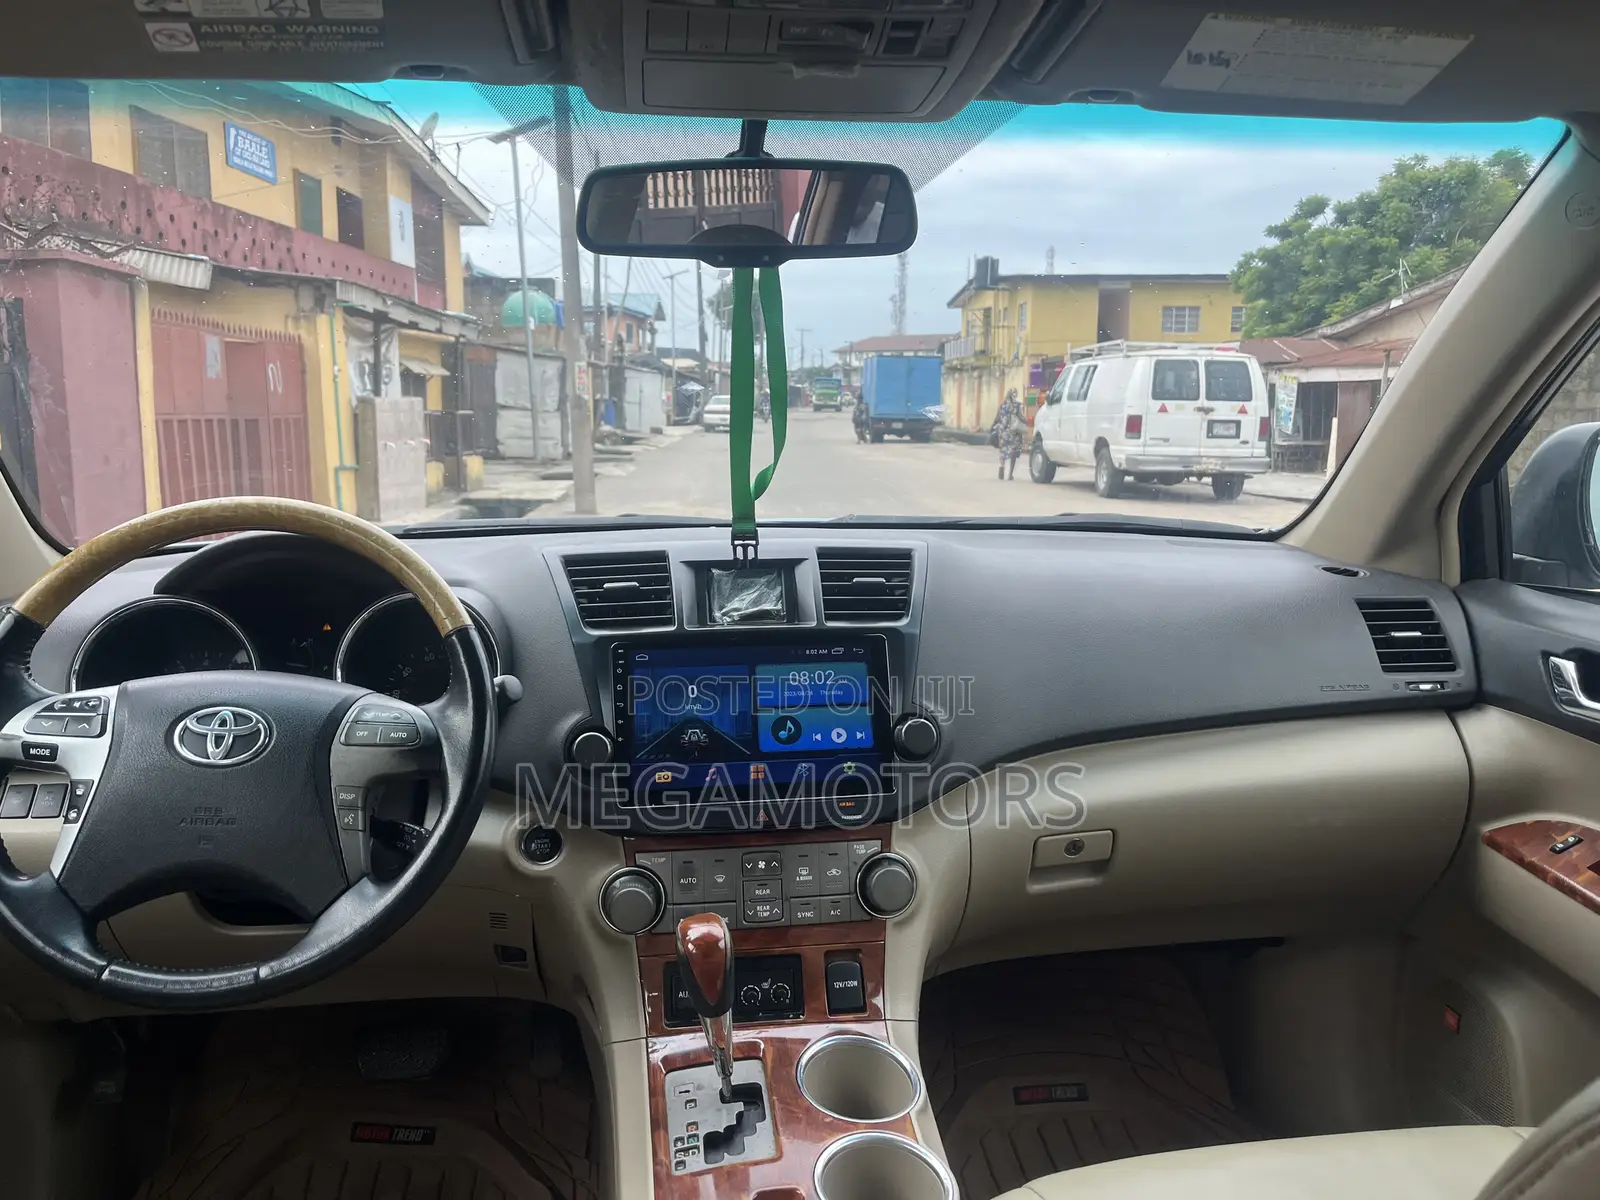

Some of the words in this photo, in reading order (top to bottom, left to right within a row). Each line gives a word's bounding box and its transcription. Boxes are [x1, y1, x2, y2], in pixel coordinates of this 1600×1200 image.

[200, 24, 276, 33] AIRBAG
[286, 24, 379, 34] WARNING
[424, 652, 435, 662] 60
[402, 666, 412, 678] 40
[789, 670, 835, 686] 08:02
[687, 684, 698, 698] 0
[389, 731, 408, 739] AUTO
[29, 747, 51, 756] MODE
[339, 792, 356, 800] DISP
[179, 817, 237, 827] AIRBAG
[833, 980, 858, 989] 12V/120W
